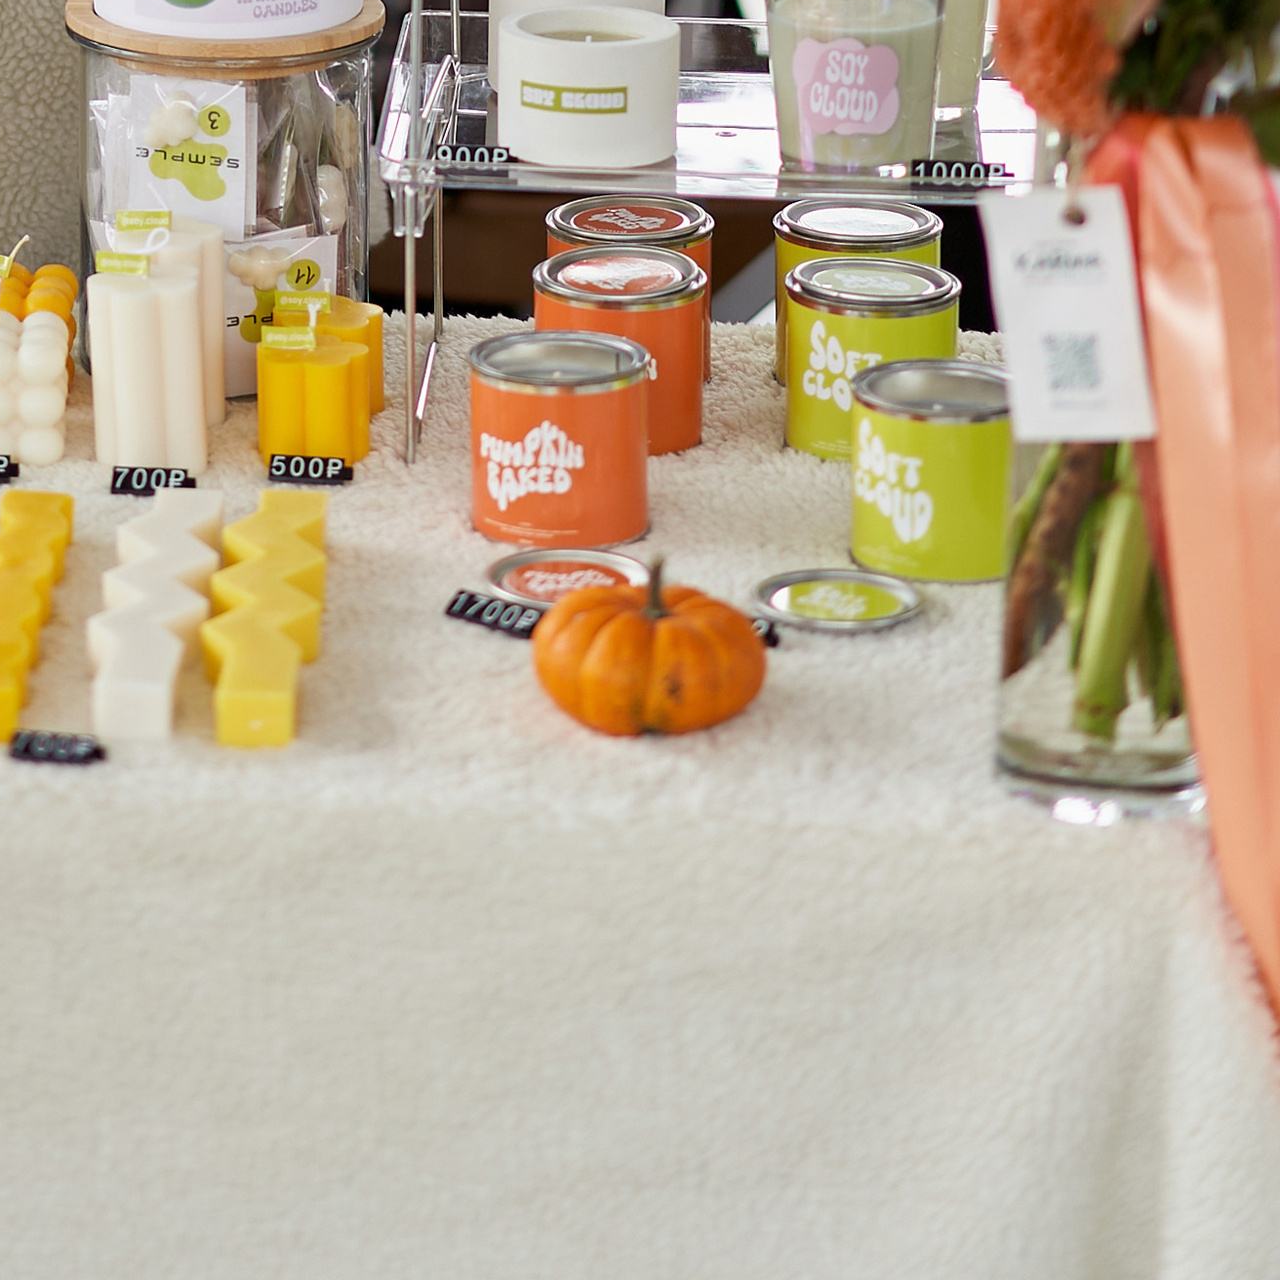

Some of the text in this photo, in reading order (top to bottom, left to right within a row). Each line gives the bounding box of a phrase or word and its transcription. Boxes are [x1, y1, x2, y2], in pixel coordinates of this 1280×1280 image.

[825, 48, 869, 85] SOY
[522, 87, 627, 111] SOY CLOUD
[809, 82, 879, 124] CLOUD
[207, 110, 221, 130] 3
[135, 146, 240, 169] SEMPLE
[802, 368, 853, 413] CLO
[480, 419, 585, 469] PUMPKIN
[858, 417, 924, 490] SOFT
[113, 467, 186, 490] 700₽
[271, 455, 344, 479] 500₽
[486, 459, 573, 512] BAKED
[854, 468, 934, 545] CLOUD
